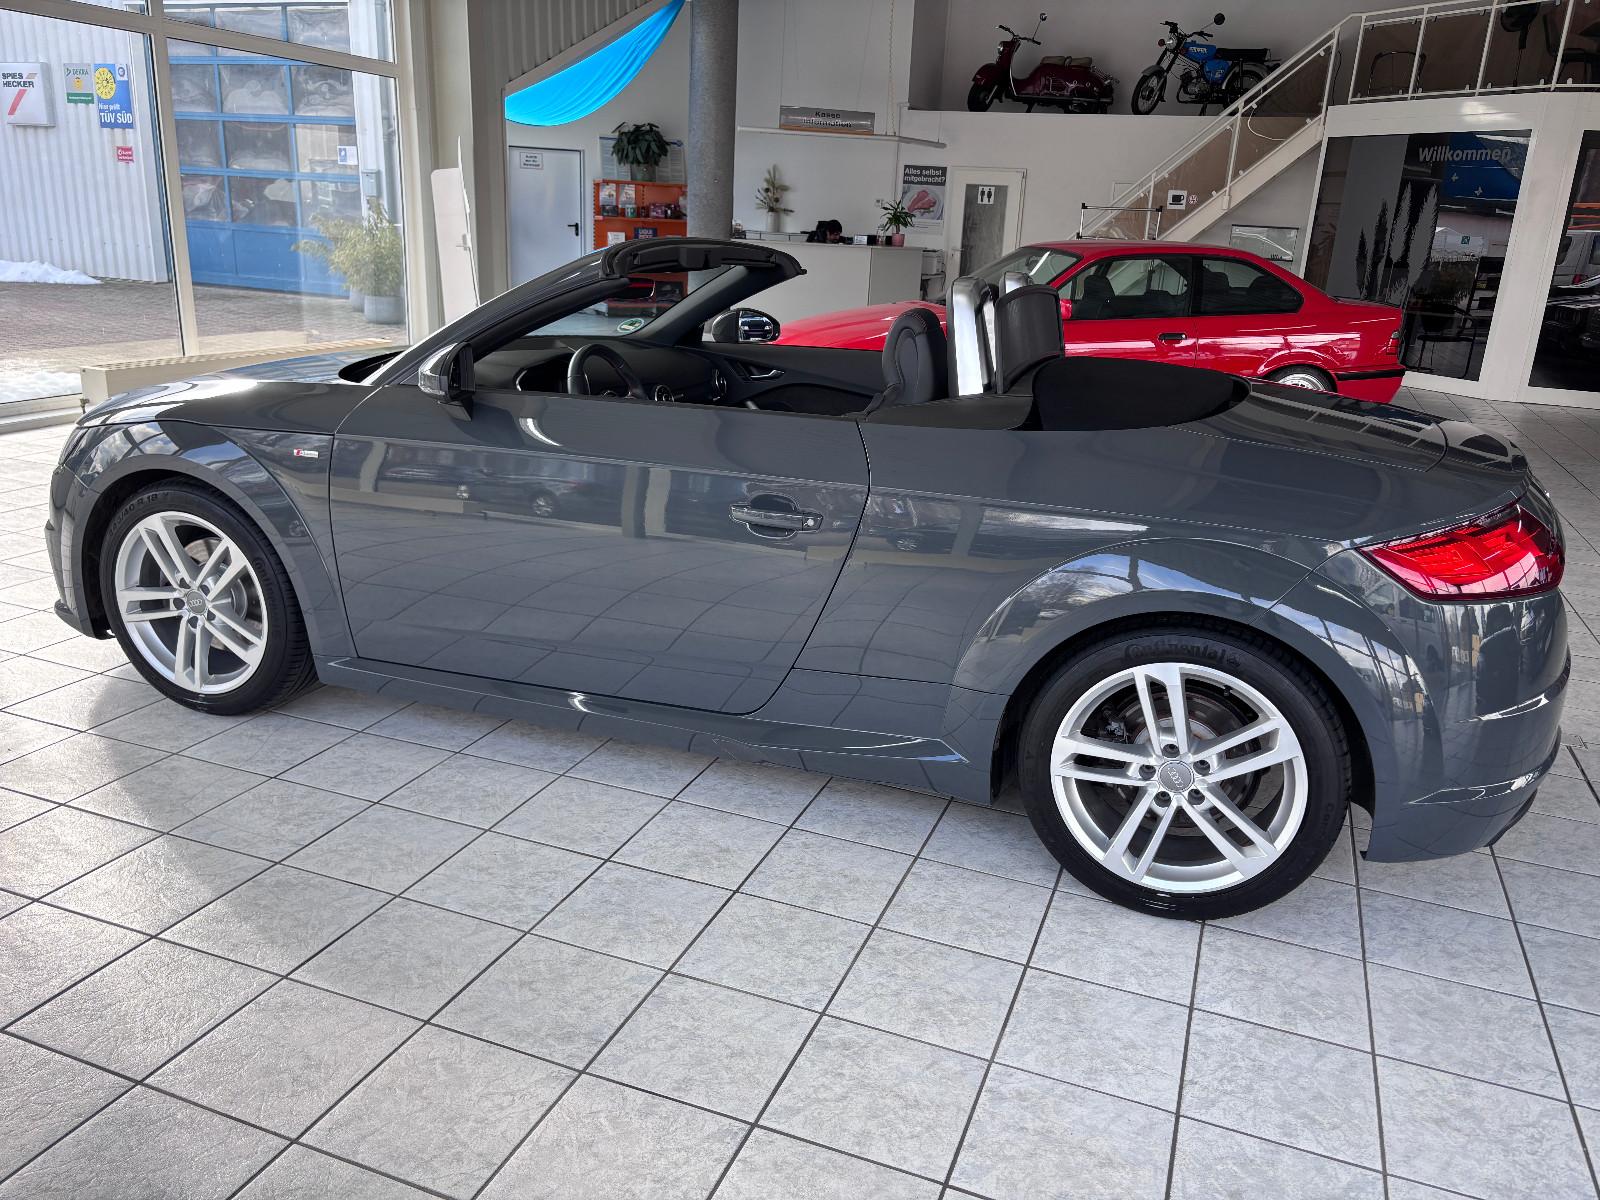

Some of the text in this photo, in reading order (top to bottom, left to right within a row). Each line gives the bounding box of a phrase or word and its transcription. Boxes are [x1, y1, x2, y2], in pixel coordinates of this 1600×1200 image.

[1, 72, 24, 80] SPIES
[2, 80, 35, 88] HECKER
[100, 110, 133, 124] TÜV SÜD
[815, 111, 841, 119] Kasse
[803, 117, 853, 128] Information
[1418, 145, 1513, 162] Willkommen
[922, 168, 942, 176] selbst
[904, 175, 946, 183] mitgebracht?
